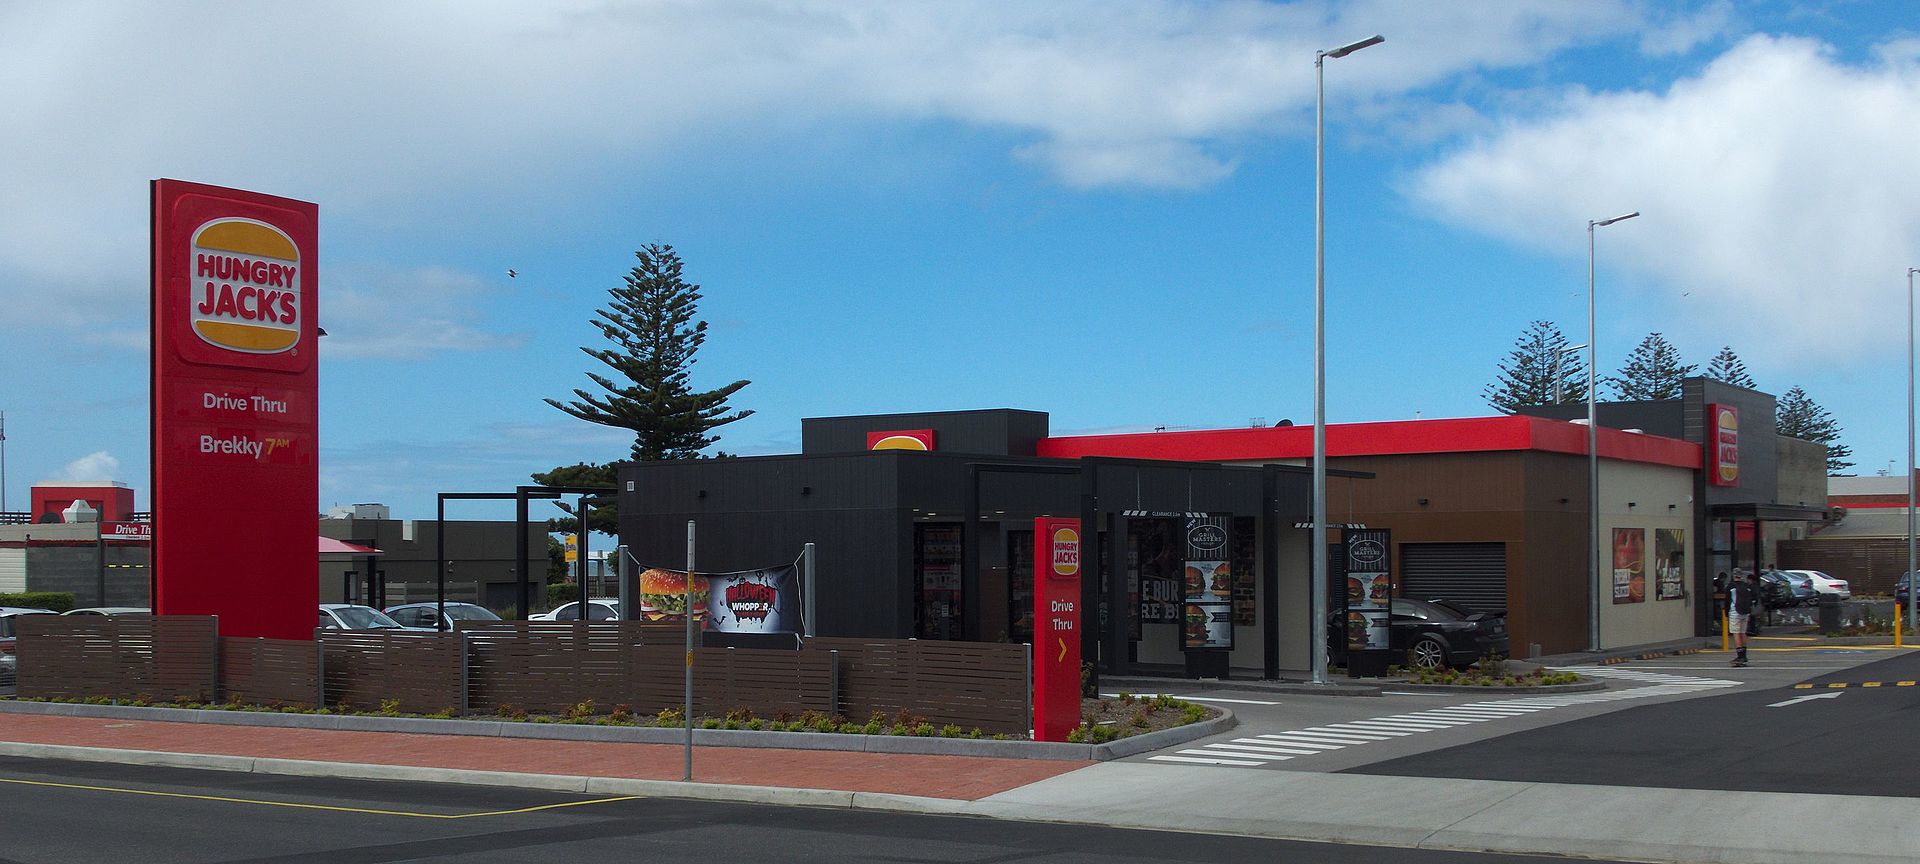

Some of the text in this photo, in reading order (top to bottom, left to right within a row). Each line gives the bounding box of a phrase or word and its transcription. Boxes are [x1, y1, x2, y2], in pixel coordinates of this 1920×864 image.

[198, 254, 296, 289] HUNGRY
[198, 282, 297, 325] JACK'S
[203, 392, 287, 414] Drive Thru
[200, 435, 290, 460] Brekky 7AM
[115, 524, 151, 535] Drive Th
[1186, 518, 1197, 529] NEW
[1054, 542, 1078, 552] HUNGRY
[1051, 598, 1074, 613] Drive
[1052, 618, 1074, 631] Thru
